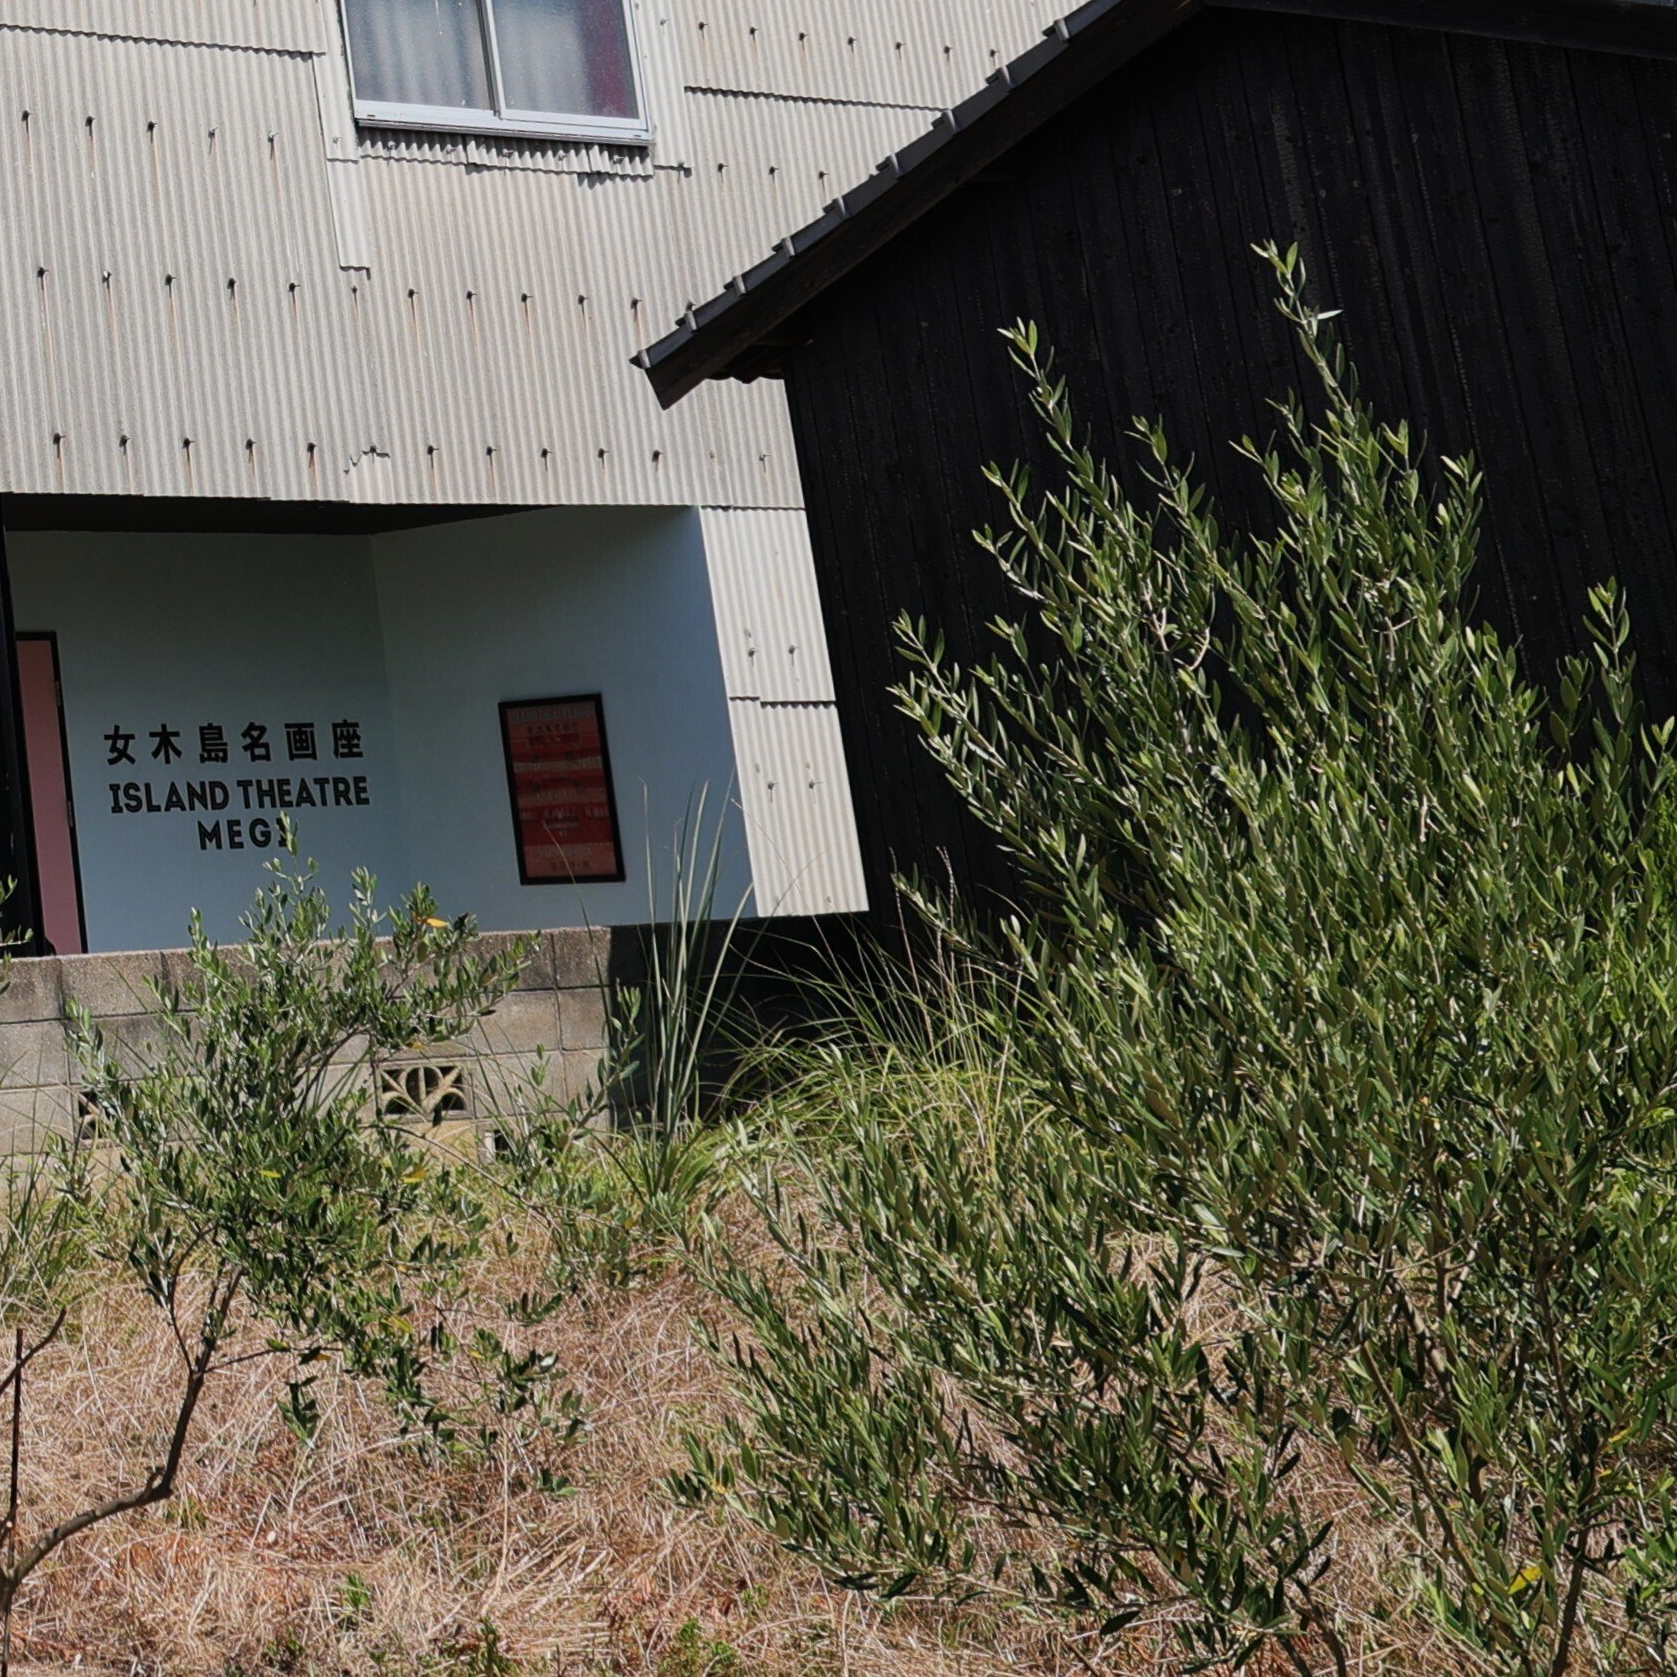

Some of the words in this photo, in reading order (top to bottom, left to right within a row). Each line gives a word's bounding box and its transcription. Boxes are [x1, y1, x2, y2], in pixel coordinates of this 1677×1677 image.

[104, 719, 364, 765] 女木島名画座
[109, 781, 229, 814] ISLAND
[237, 776, 370, 809] THEATRE
